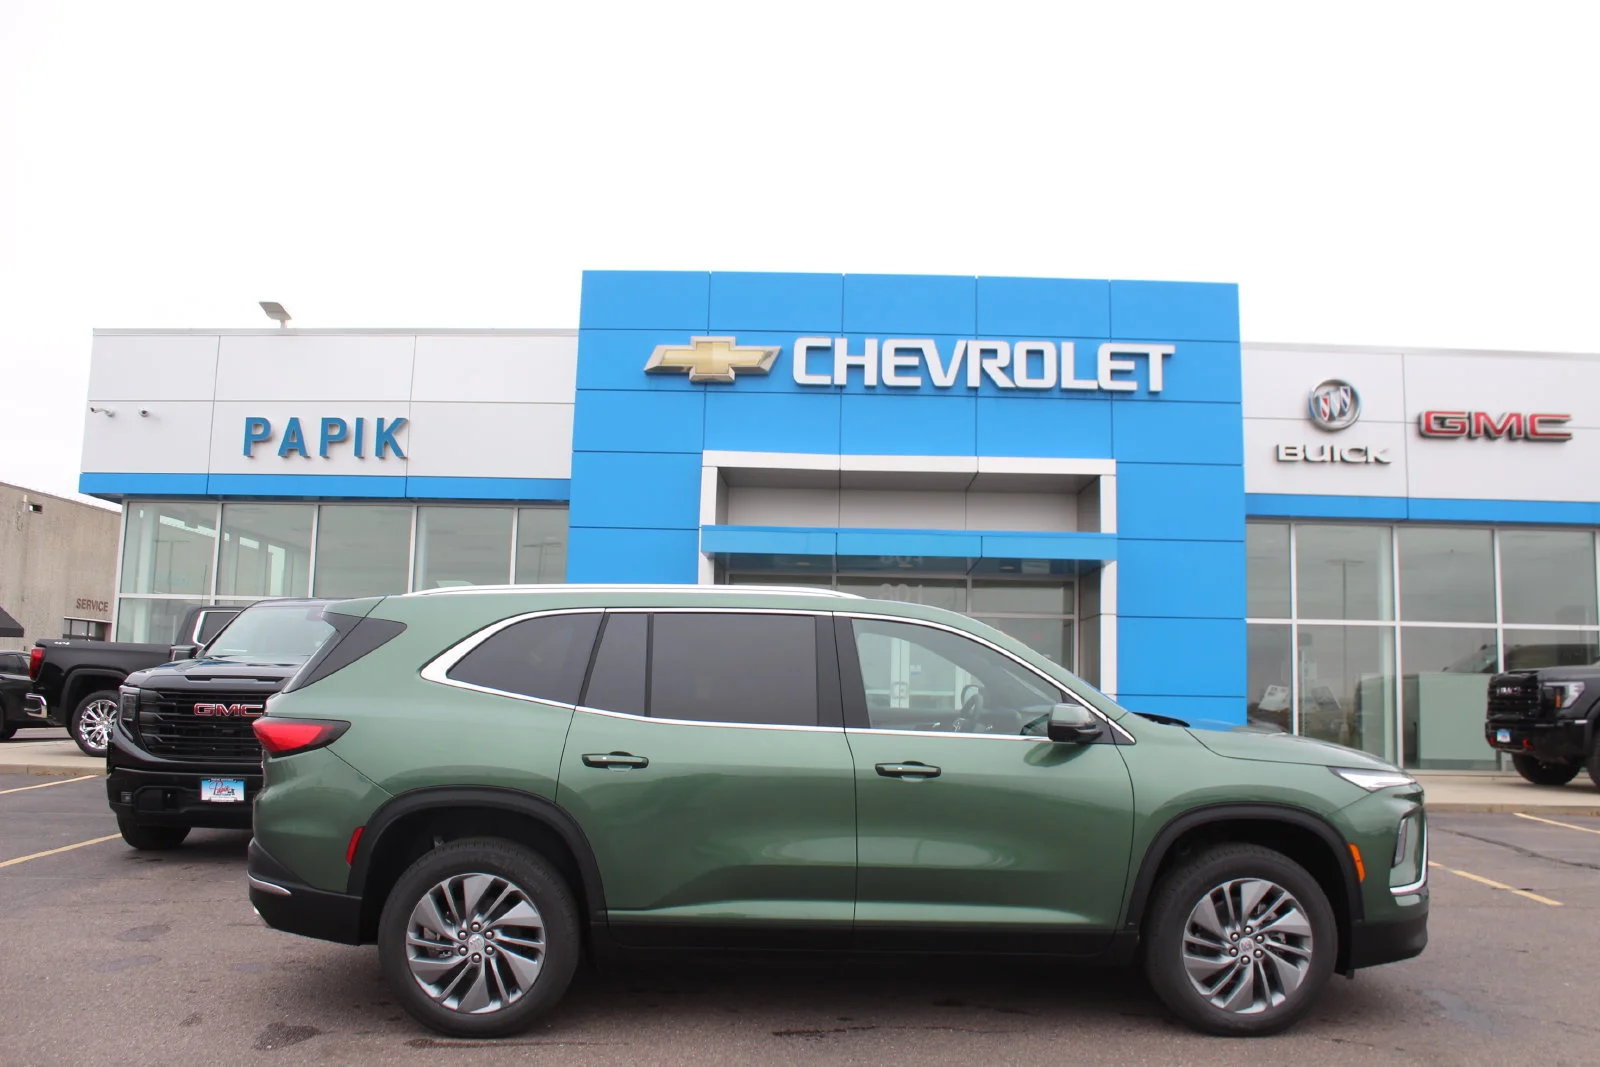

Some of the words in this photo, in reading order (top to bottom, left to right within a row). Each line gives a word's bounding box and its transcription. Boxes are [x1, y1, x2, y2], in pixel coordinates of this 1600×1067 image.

[793, 337, 1176, 393] CHEVROLET
[243, 417, 408, 459] PAPIK
[1419, 410, 1573, 441] GMC
[1276, 444, 1392, 465] BUICK
[76, 598, 109, 612] SERVICE
[194, 703, 263, 717] GMC
